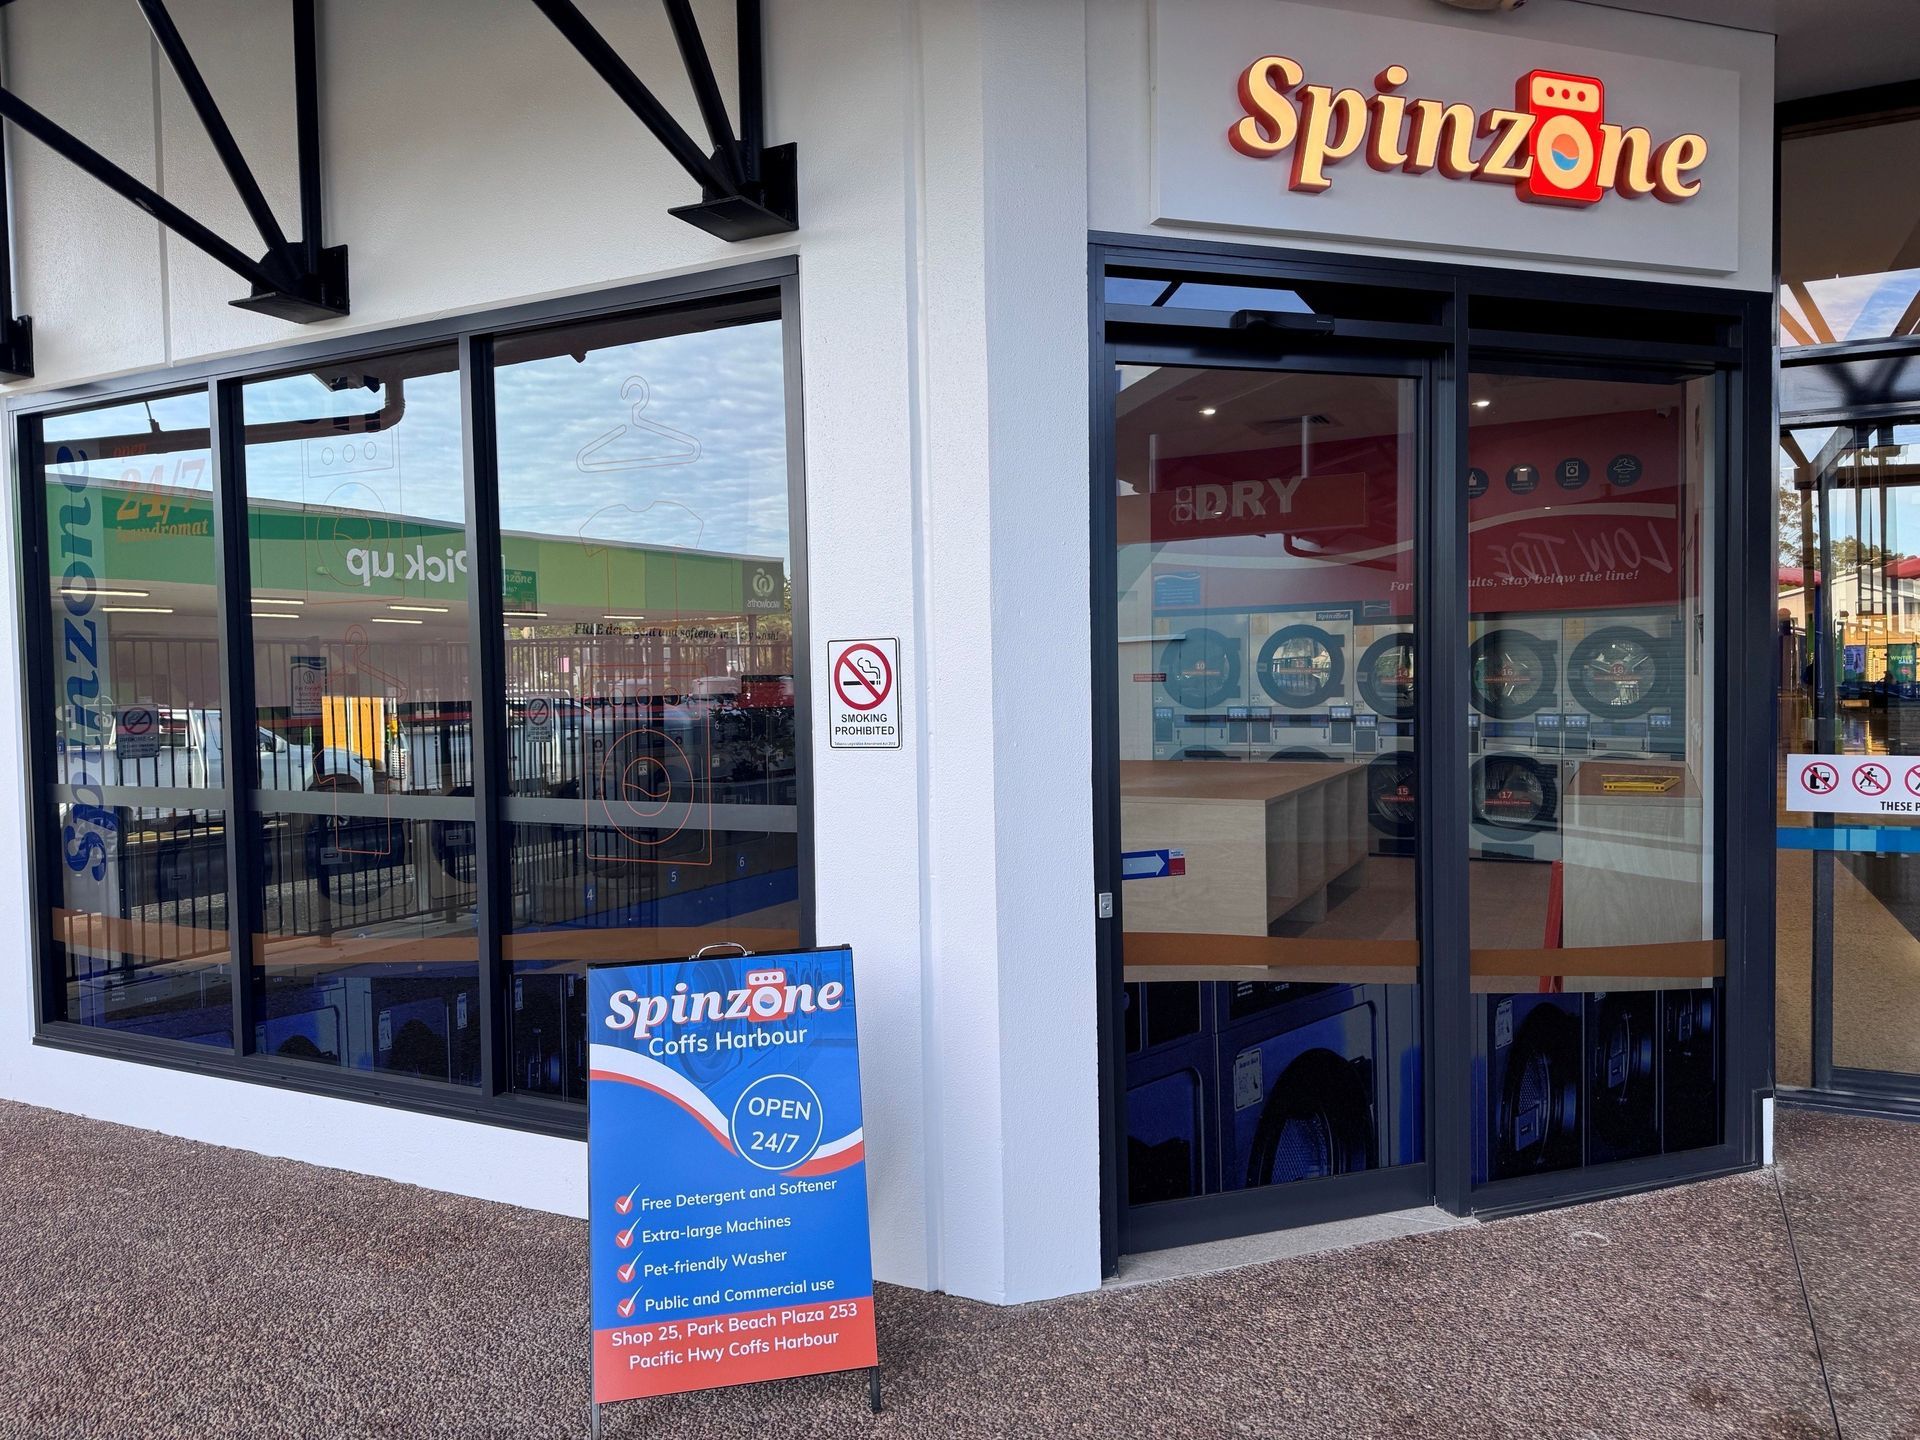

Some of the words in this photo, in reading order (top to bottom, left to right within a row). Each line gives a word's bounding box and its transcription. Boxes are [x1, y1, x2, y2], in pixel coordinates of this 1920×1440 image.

[1229, 55, 1708, 209] Spinzone
[116, 458, 206, 525] 24/7
[1196, 475, 1304, 520] DRY
[115, 519, 208, 543] laundromat
[1390, 581, 1413, 592] For
[1501, 575, 1531, 588] stay
[1535, 573, 1576, 584] below
[1579, 571, 1602, 582] the
[1605, 570, 1639, 581] line!
[575, 622, 604, 635] FREE
[680, 627, 717, 640] softener
[56, 446, 118, 882] Spinzone
[835, 726, 895, 735] PROHIBITED
[841, 713, 888, 723] SMOKING
[1880, 801, 1912, 812] THESE
[738, 856, 745, 868] 6
[670, 871, 677, 883] 5
[586, 888, 594, 901] 4
[604, 968, 844, 1039] Spinzone
[649, 1033, 708, 1056] Coffs
[716, 1028, 808, 1050] Harbour
[748, 1097, 811, 1121] OPEN
[750, 1131, 800, 1153] 24/7
[641, 1197, 672, 1211] Free
[676, 1189, 746, 1206] Detergent
[749, 1184, 776, 1199] and
[780, 1179, 838, 1195] Softener
[642, 1224, 722, 1243] Extra-large
[726, 1215, 791, 1234] Machines
[644, 1256, 728, 1277] Pet-friendly
[731, 1249, 787, 1267] Washer
[645, 1295, 689, 1312] Public
[693, 1290, 720, 1306] and
[724, 1280, 807, 1302] Commercial
[811, 1279, 835, 1291] use
[611, 1331, 653, 1347] Shop
[658, 1325, 683, 1341] 25,
[687, 1318, 724, 1338] Park
[729, 1312, 777, 1332] Beach
[782, 1306, 824, 1325] Plaza
[829, 1302, 857, 1318] 253
[629, 1351, 683, 1370] Pacific
[688, 1346, 724, 1362] Hwy
[729, 1340, 770, 1357] Coffs
[774, 1331, 839, 1351] Harbour
